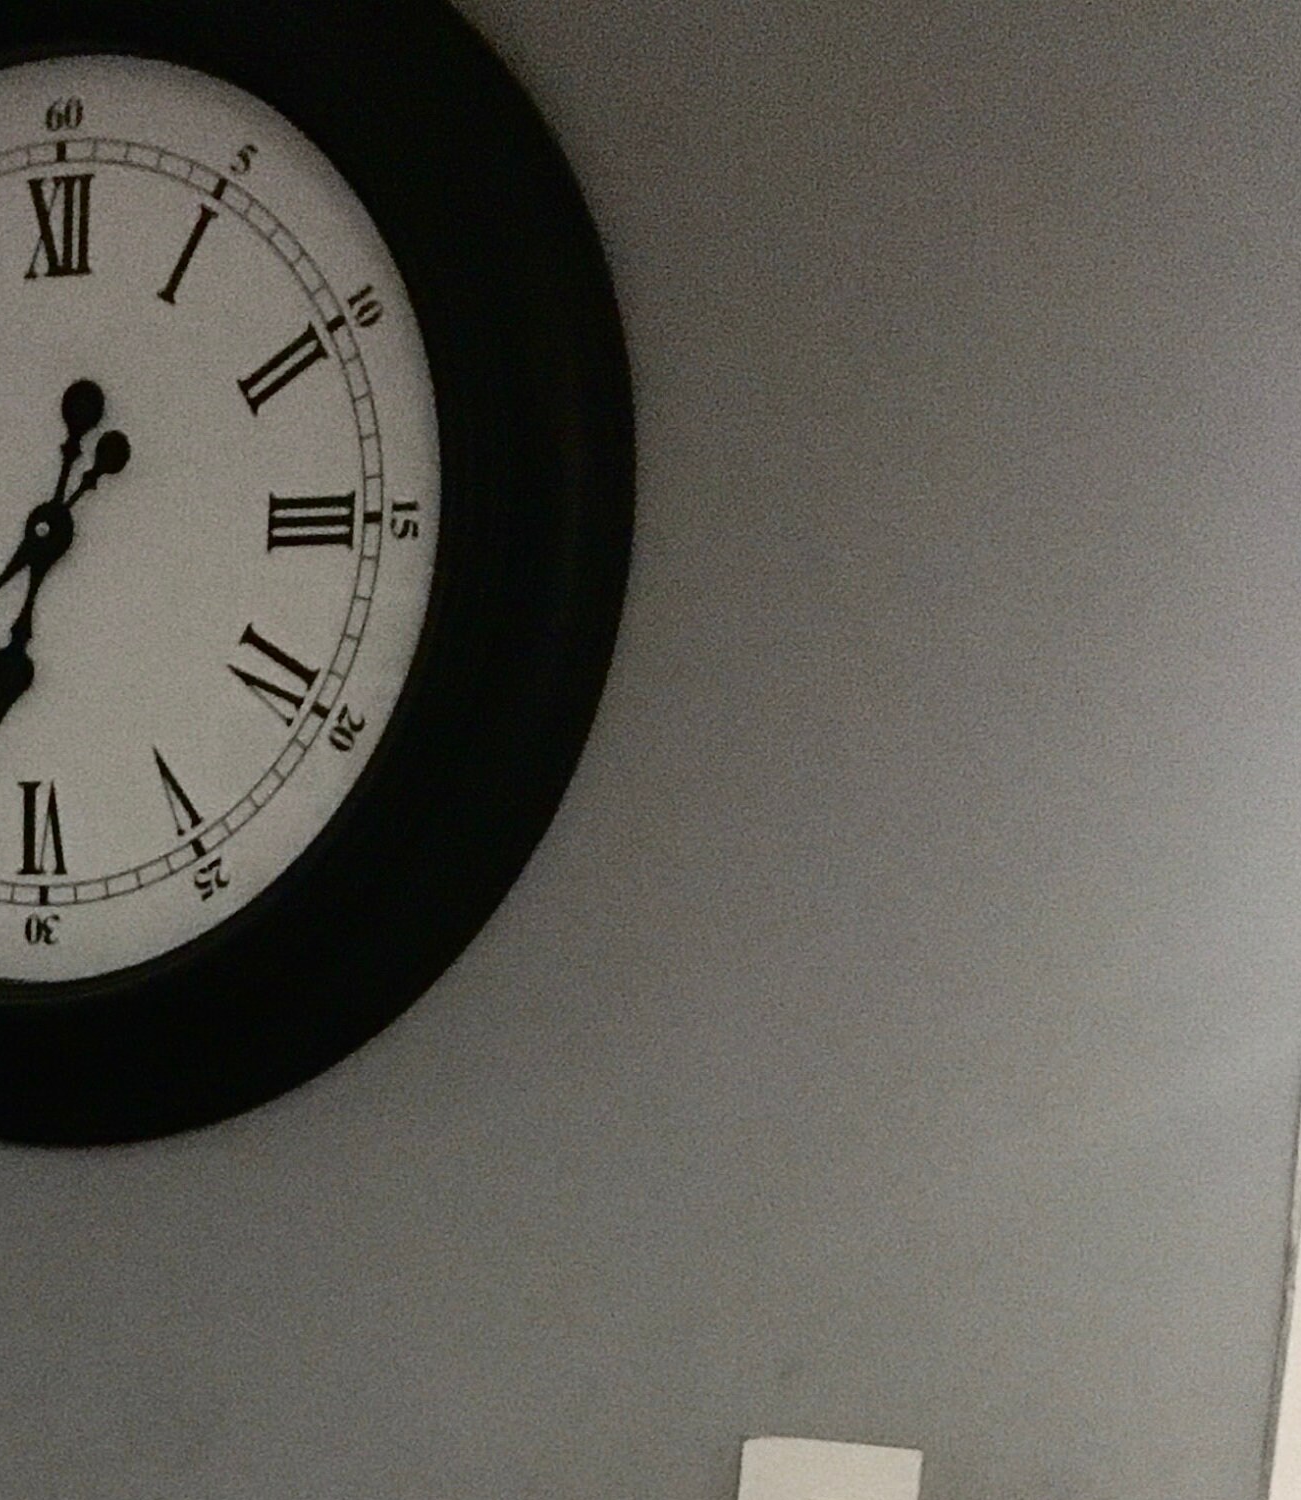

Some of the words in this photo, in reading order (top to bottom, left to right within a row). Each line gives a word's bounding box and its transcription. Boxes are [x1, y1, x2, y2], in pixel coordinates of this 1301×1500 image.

[44, 98, 84, 132] 60
[231, 144, 258, 174] 5
[24, 173, 94, 281] XII
[157, 203, 219, 304] I
[346, 284, 384, 328] 10
[237, 321, 329, 416] II
[267, 491, 356, 554] III
[390, 500, 420, 540] 15
[227, 623, 320, 727] IV
[328, 702, 366, 751] 20
[153, 746, 204, 836] V
[16, 780, 68, 876] VI
[193, 856, 230, 901] 25
[24, 914, 60, 946] 30
